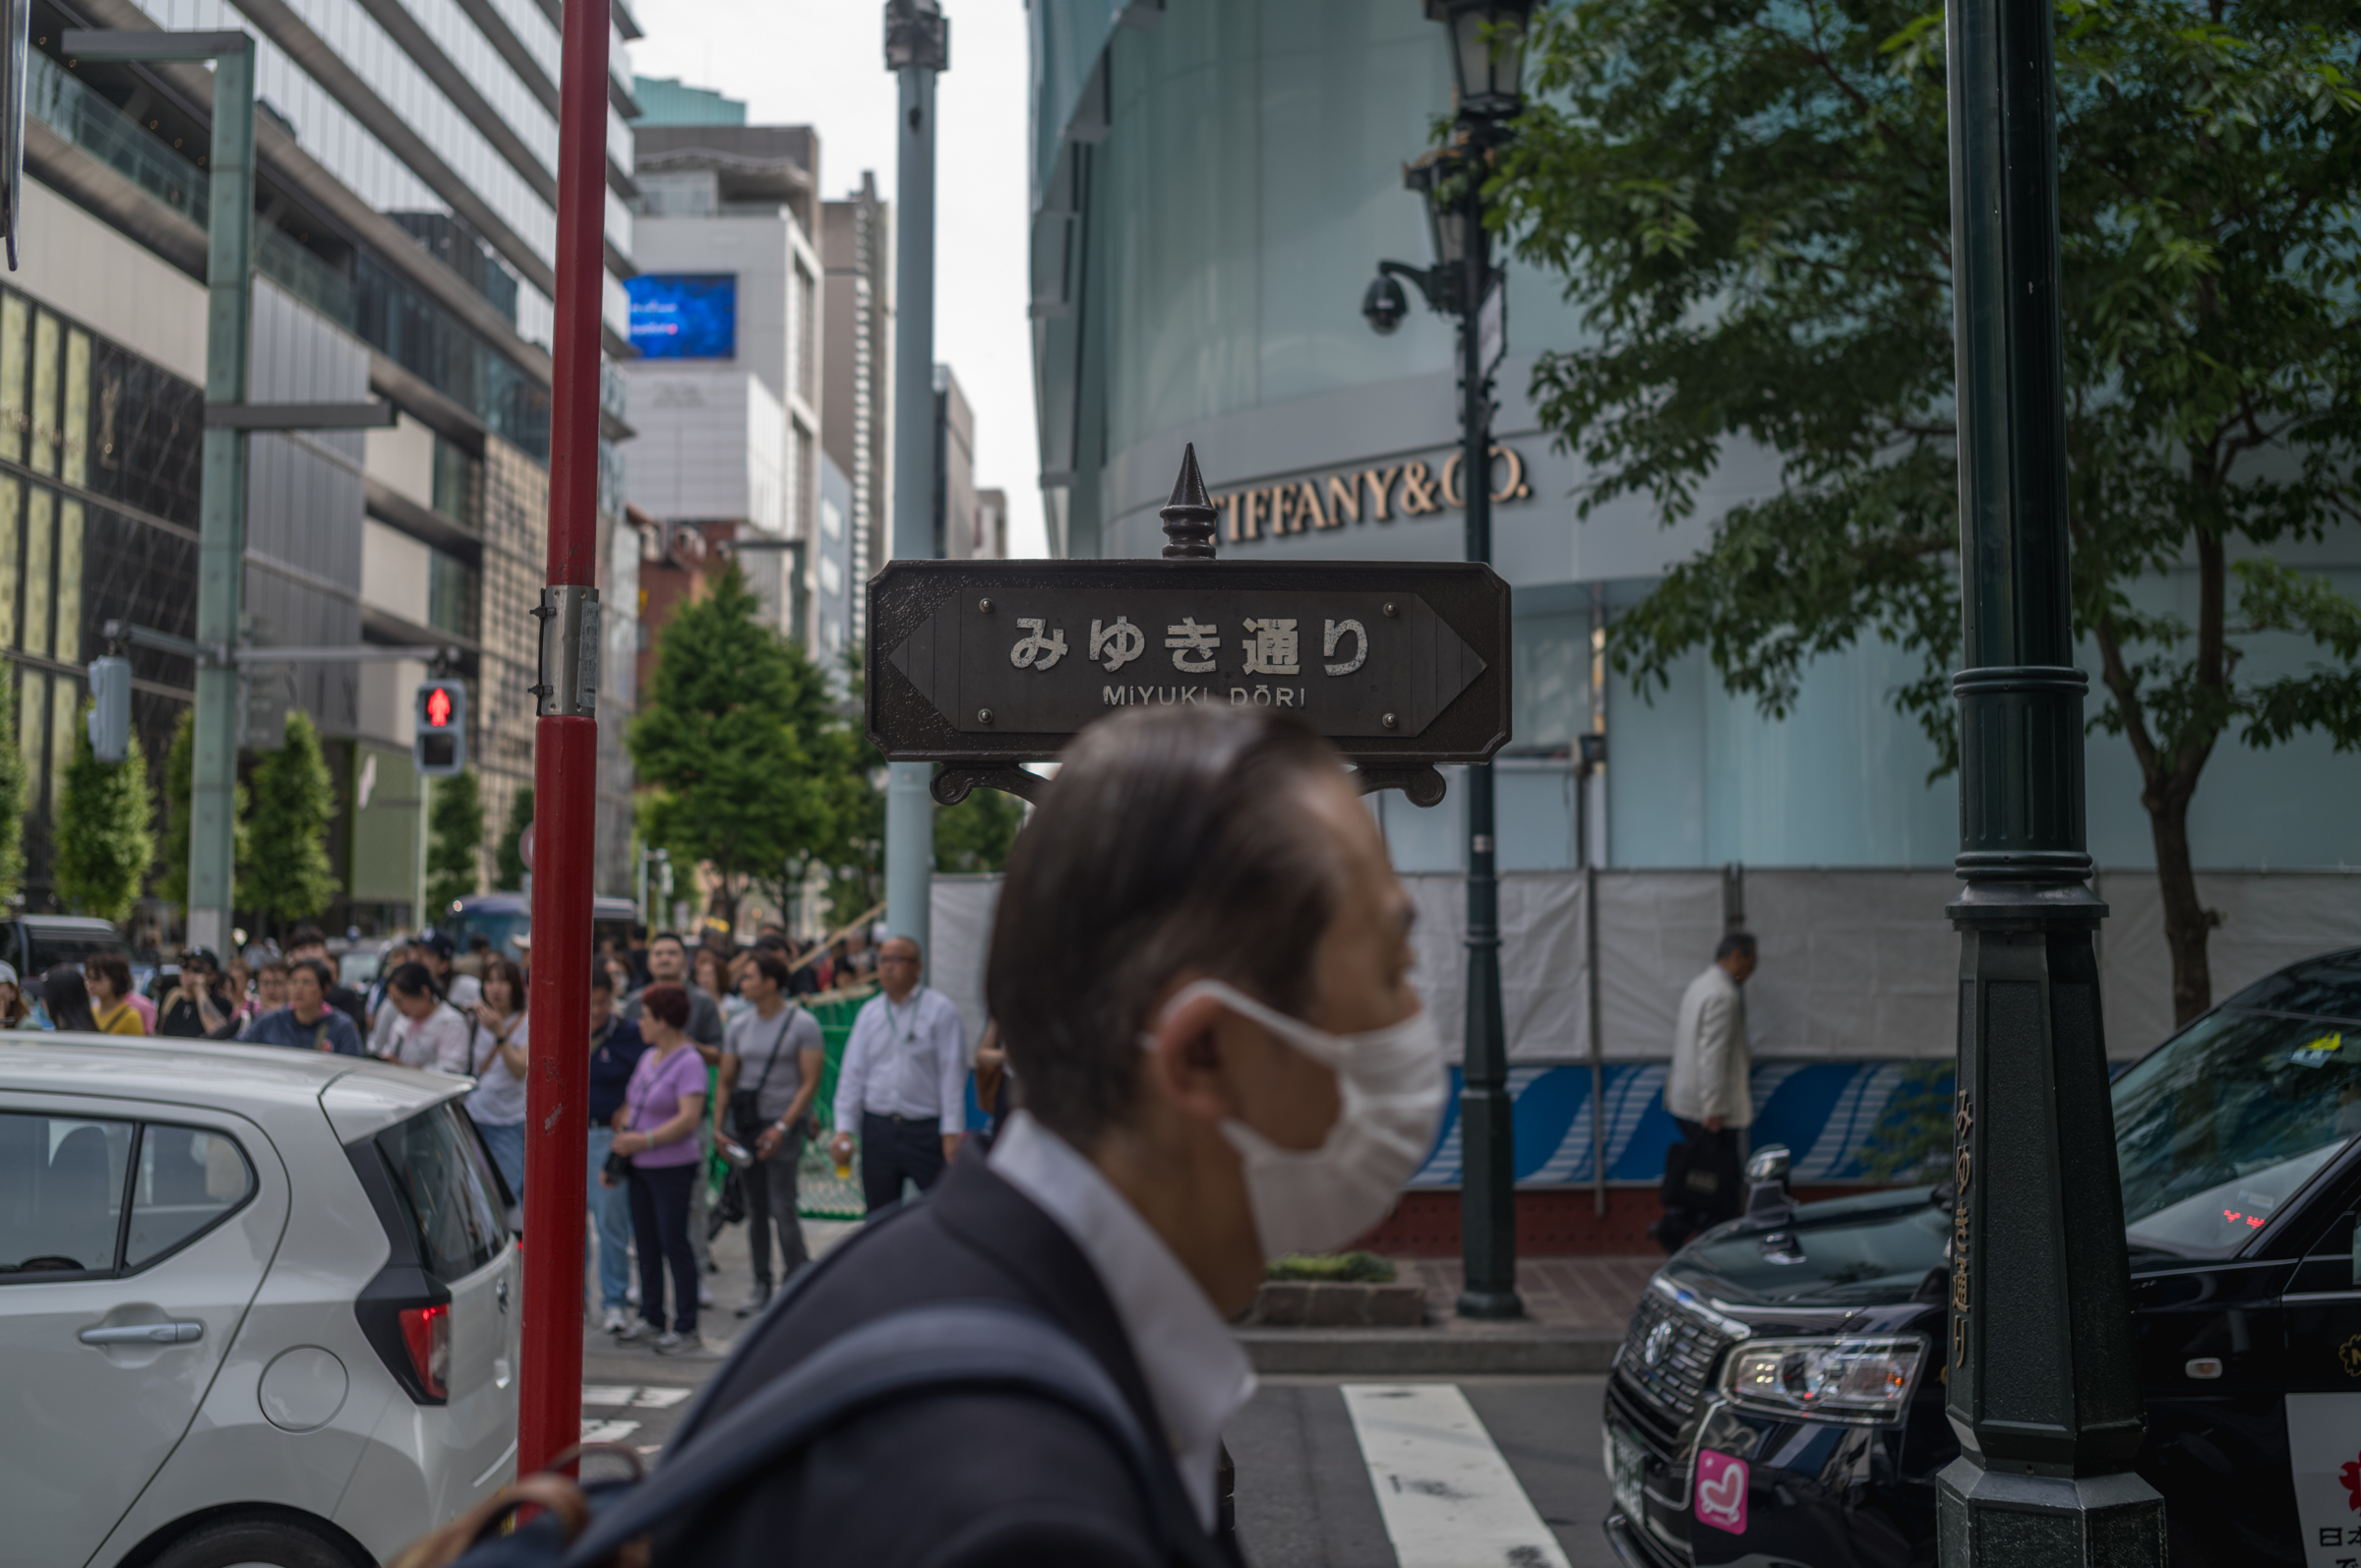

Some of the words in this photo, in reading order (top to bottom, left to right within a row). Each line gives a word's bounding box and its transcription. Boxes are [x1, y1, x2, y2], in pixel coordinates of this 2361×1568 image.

[1009, 615, 1369, 677] みゆき通り
[1102, 686, 1208, 706] MIYUKI
[1230, 685, 1305, 707] DŌRI
[1953, 1089, 1971, 1368] みゆき通り
